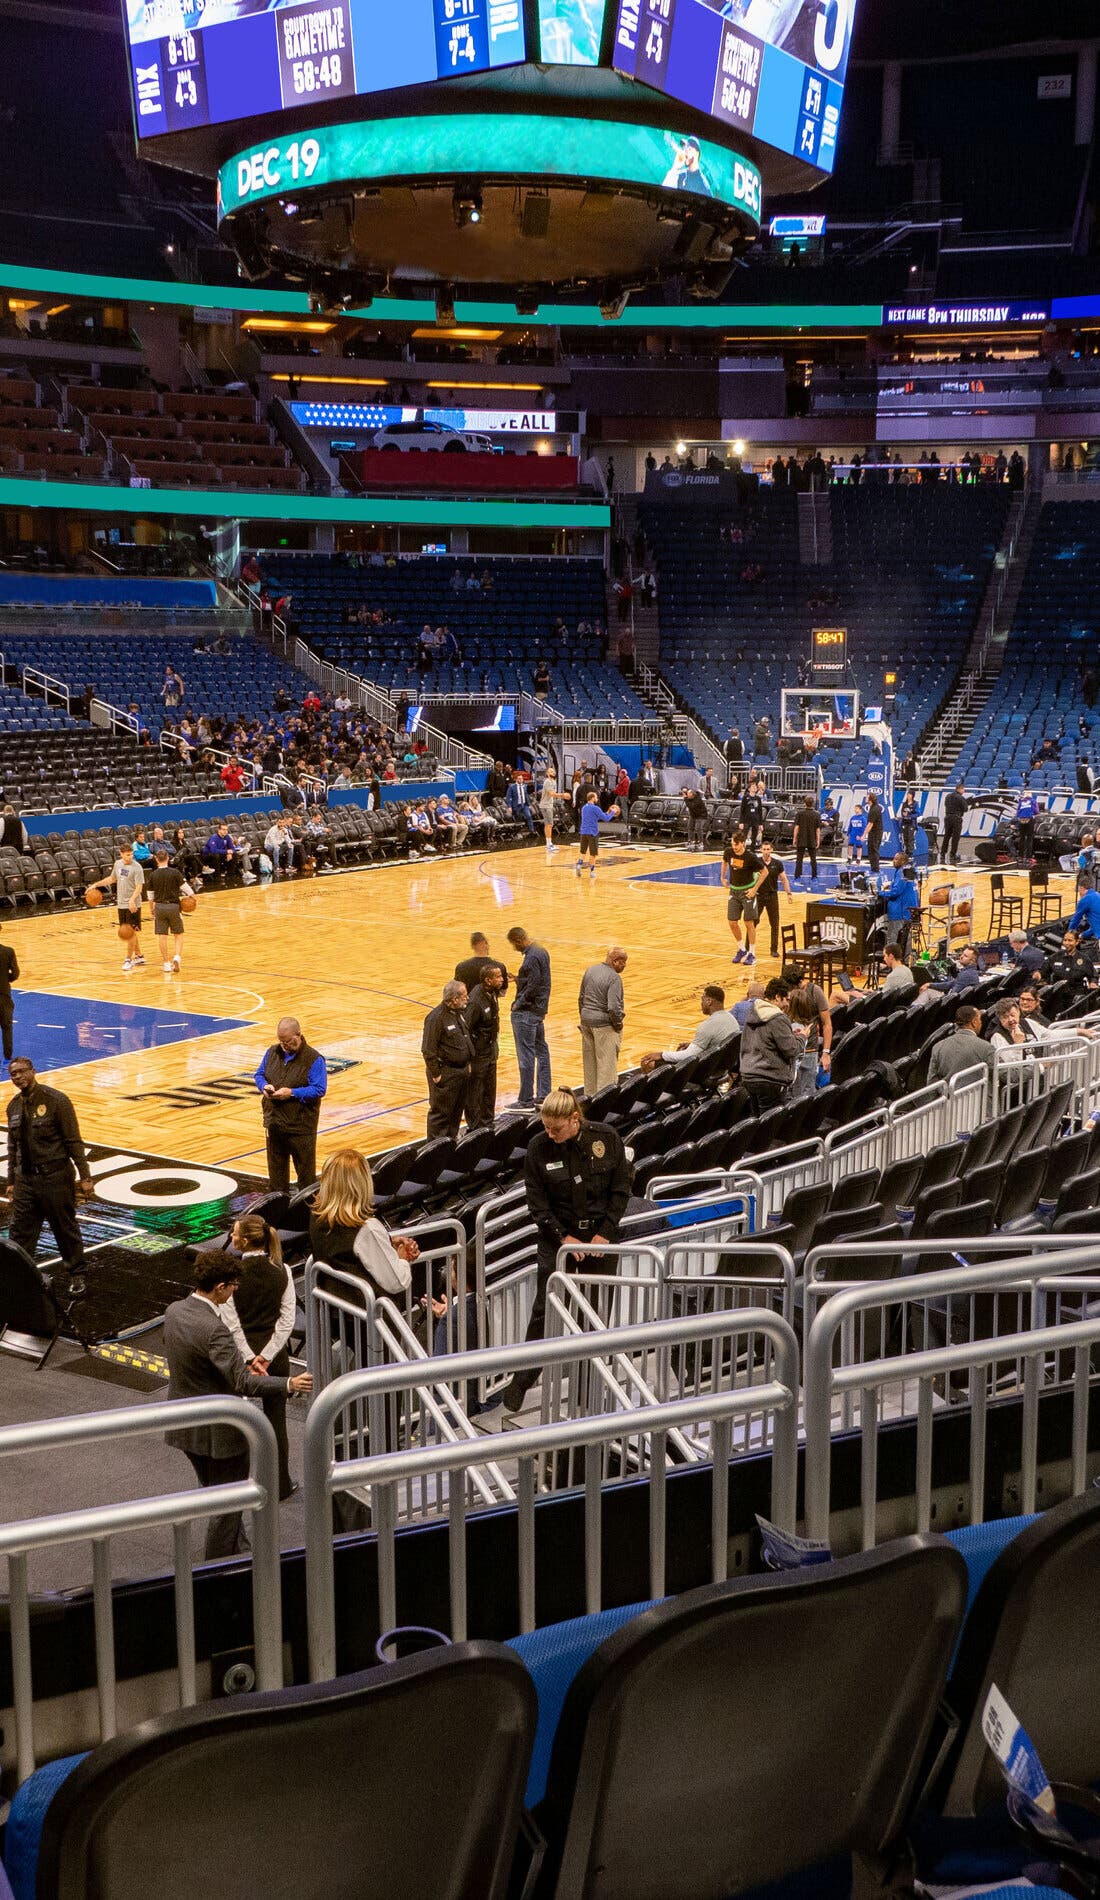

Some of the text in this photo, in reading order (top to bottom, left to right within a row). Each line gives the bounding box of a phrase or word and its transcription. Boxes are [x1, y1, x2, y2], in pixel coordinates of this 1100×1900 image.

[283, 9, 332, 36] COUNTDOWN
[284, 24, 346, 60] GAMETIME
[448, 36, 476, 66] 7-4
[135, 63, 162, 115] PHX
[292, 54, 342, 94] 58:48
[820, 104, 839, 148] ORL
[237, 138, 320, 197] DEC 19
[734, 161, 760, 212] DEC
[888, 309, 906, 321] NEXT
[906, 308, 926, 320] GAME
[928, 306, 947, 324] 8PM
[520, 414, 550, 429] ALL
[685, 474, 720, 484] FLORIDA
[816, 632, 844, 644] 58:47
